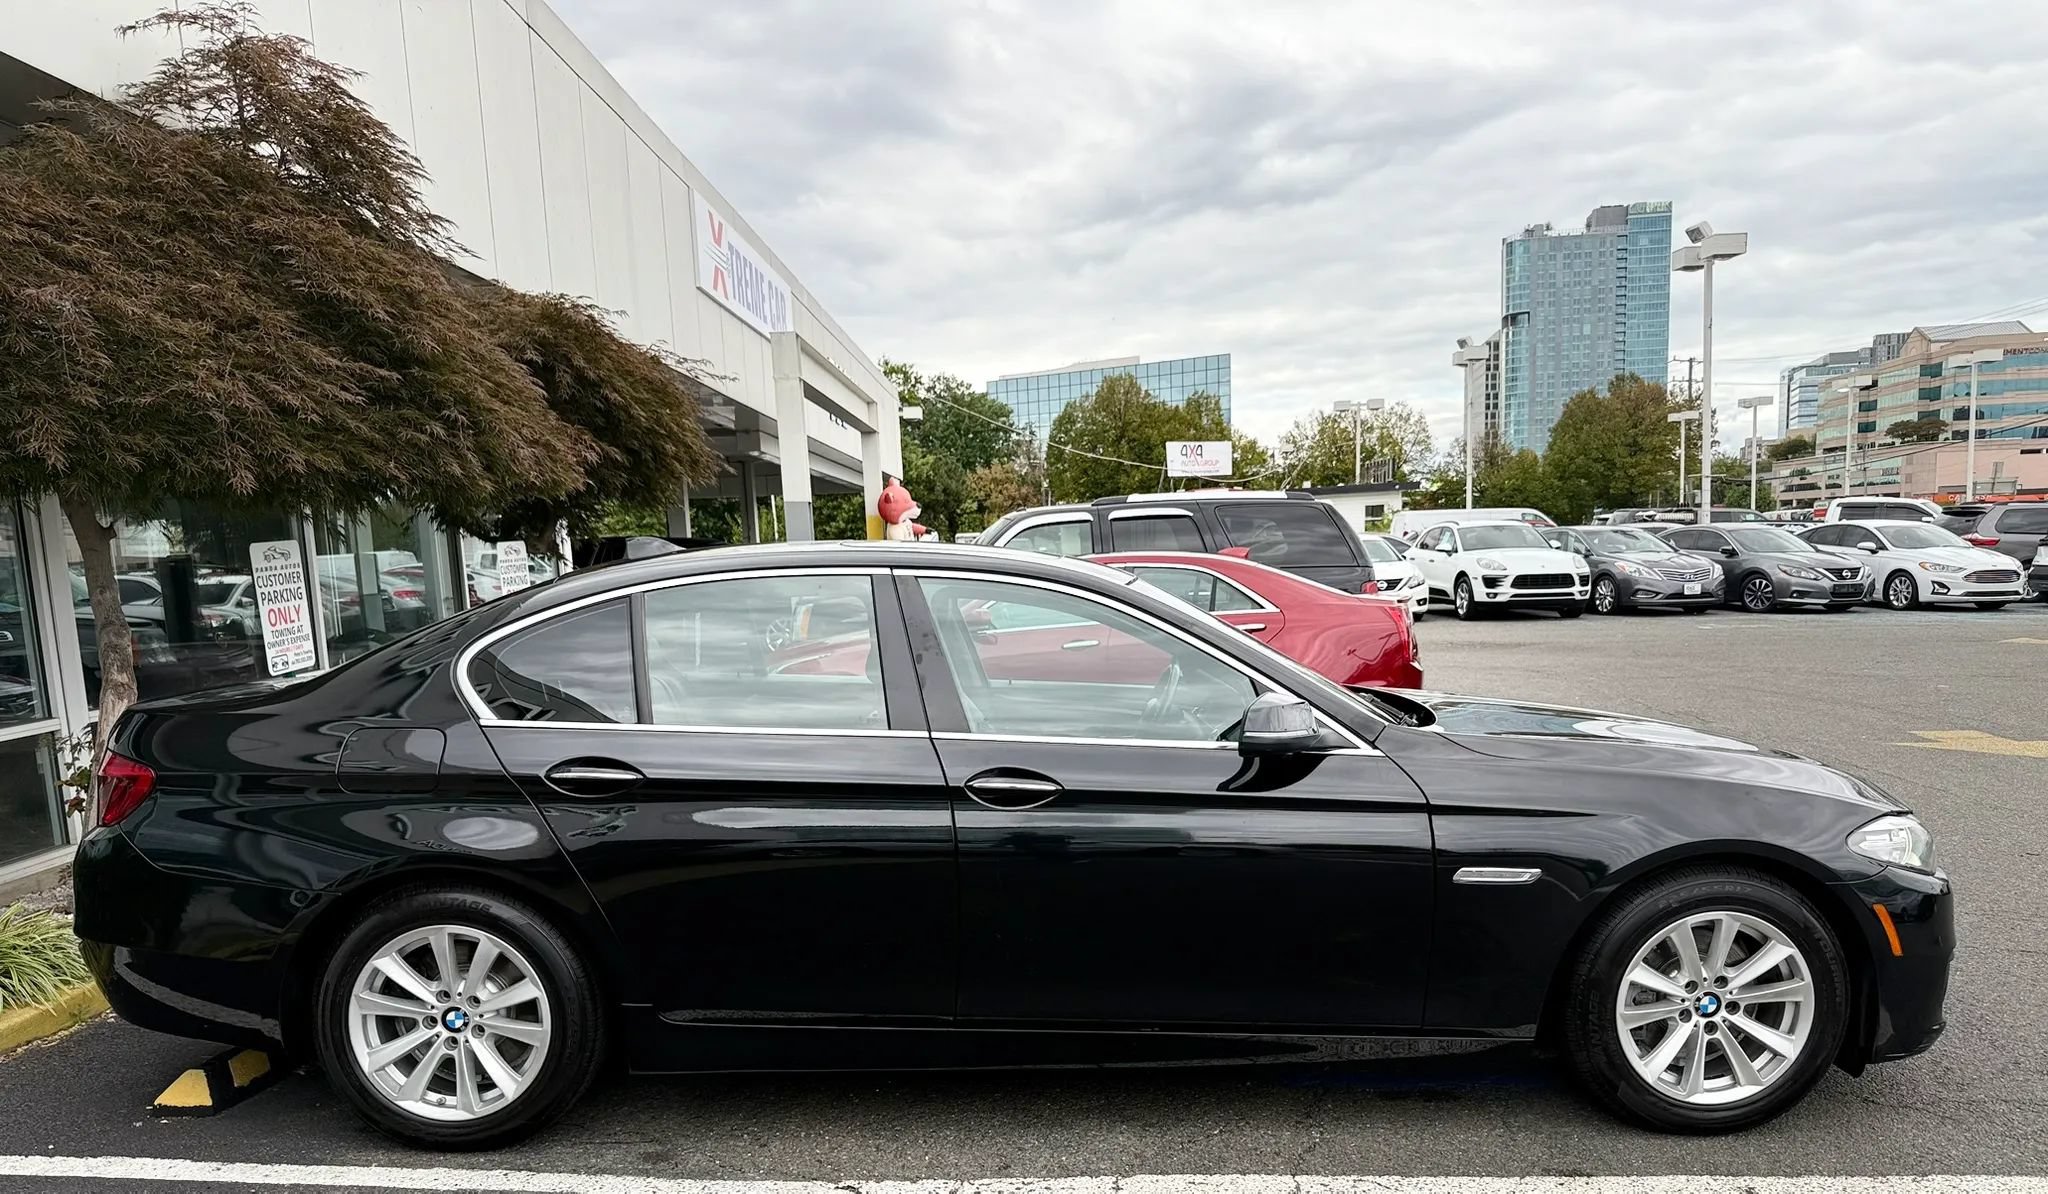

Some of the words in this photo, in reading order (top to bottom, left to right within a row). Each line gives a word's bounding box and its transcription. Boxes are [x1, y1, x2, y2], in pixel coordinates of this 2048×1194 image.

[1181, 444, 1203, 459] 4X4
[255, 565, 278, 573] PANDA
[256, 571, 303, 589] CUSTOMER
[502, 574, 529, 587] PARKING
[260, 586, 303, 606] PARKING
[268, 604, 301, 628] ONLY
[271, 627, 296, 640] TOWING
[296, 625, 304, 634] AT
[267, 638, 290, 650] OWNER'S
[290, 633, 311, 645] EXPENSE
